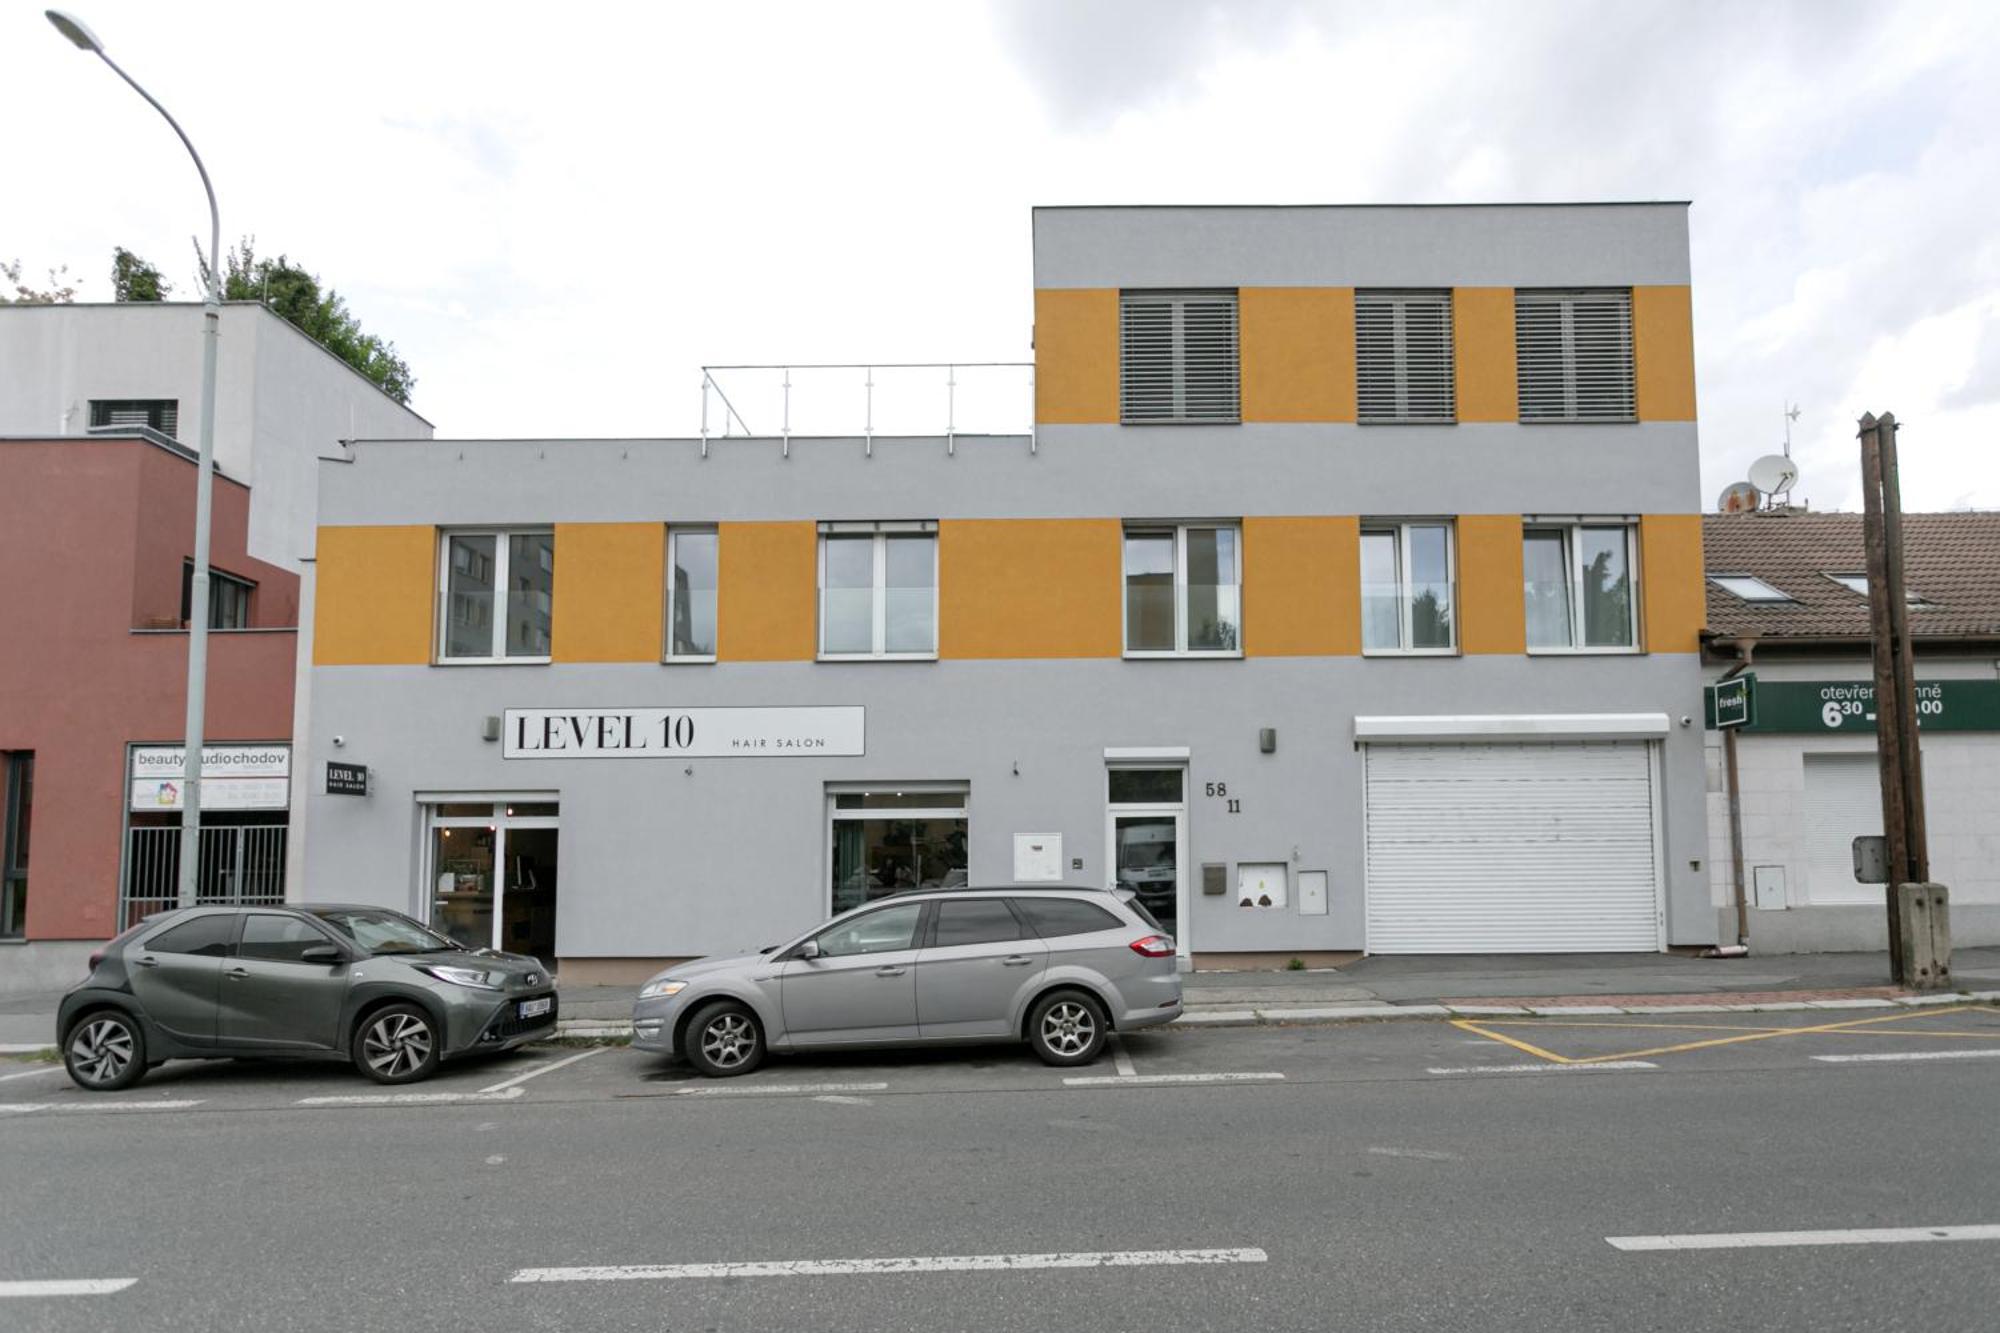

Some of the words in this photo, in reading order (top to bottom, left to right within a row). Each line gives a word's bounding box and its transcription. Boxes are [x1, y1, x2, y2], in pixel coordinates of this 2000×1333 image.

[1719, 695, 1742, 708] fresh
[515, 715, 647, 750] LEVEL
[658, 714, 695, 749] 10
[732, 739, 767, 748] HAIR
[776, 738, 826, 748] SALON
[1206, 782, 1226, 797] 58
[1227, 799, 1241, 813] 11
